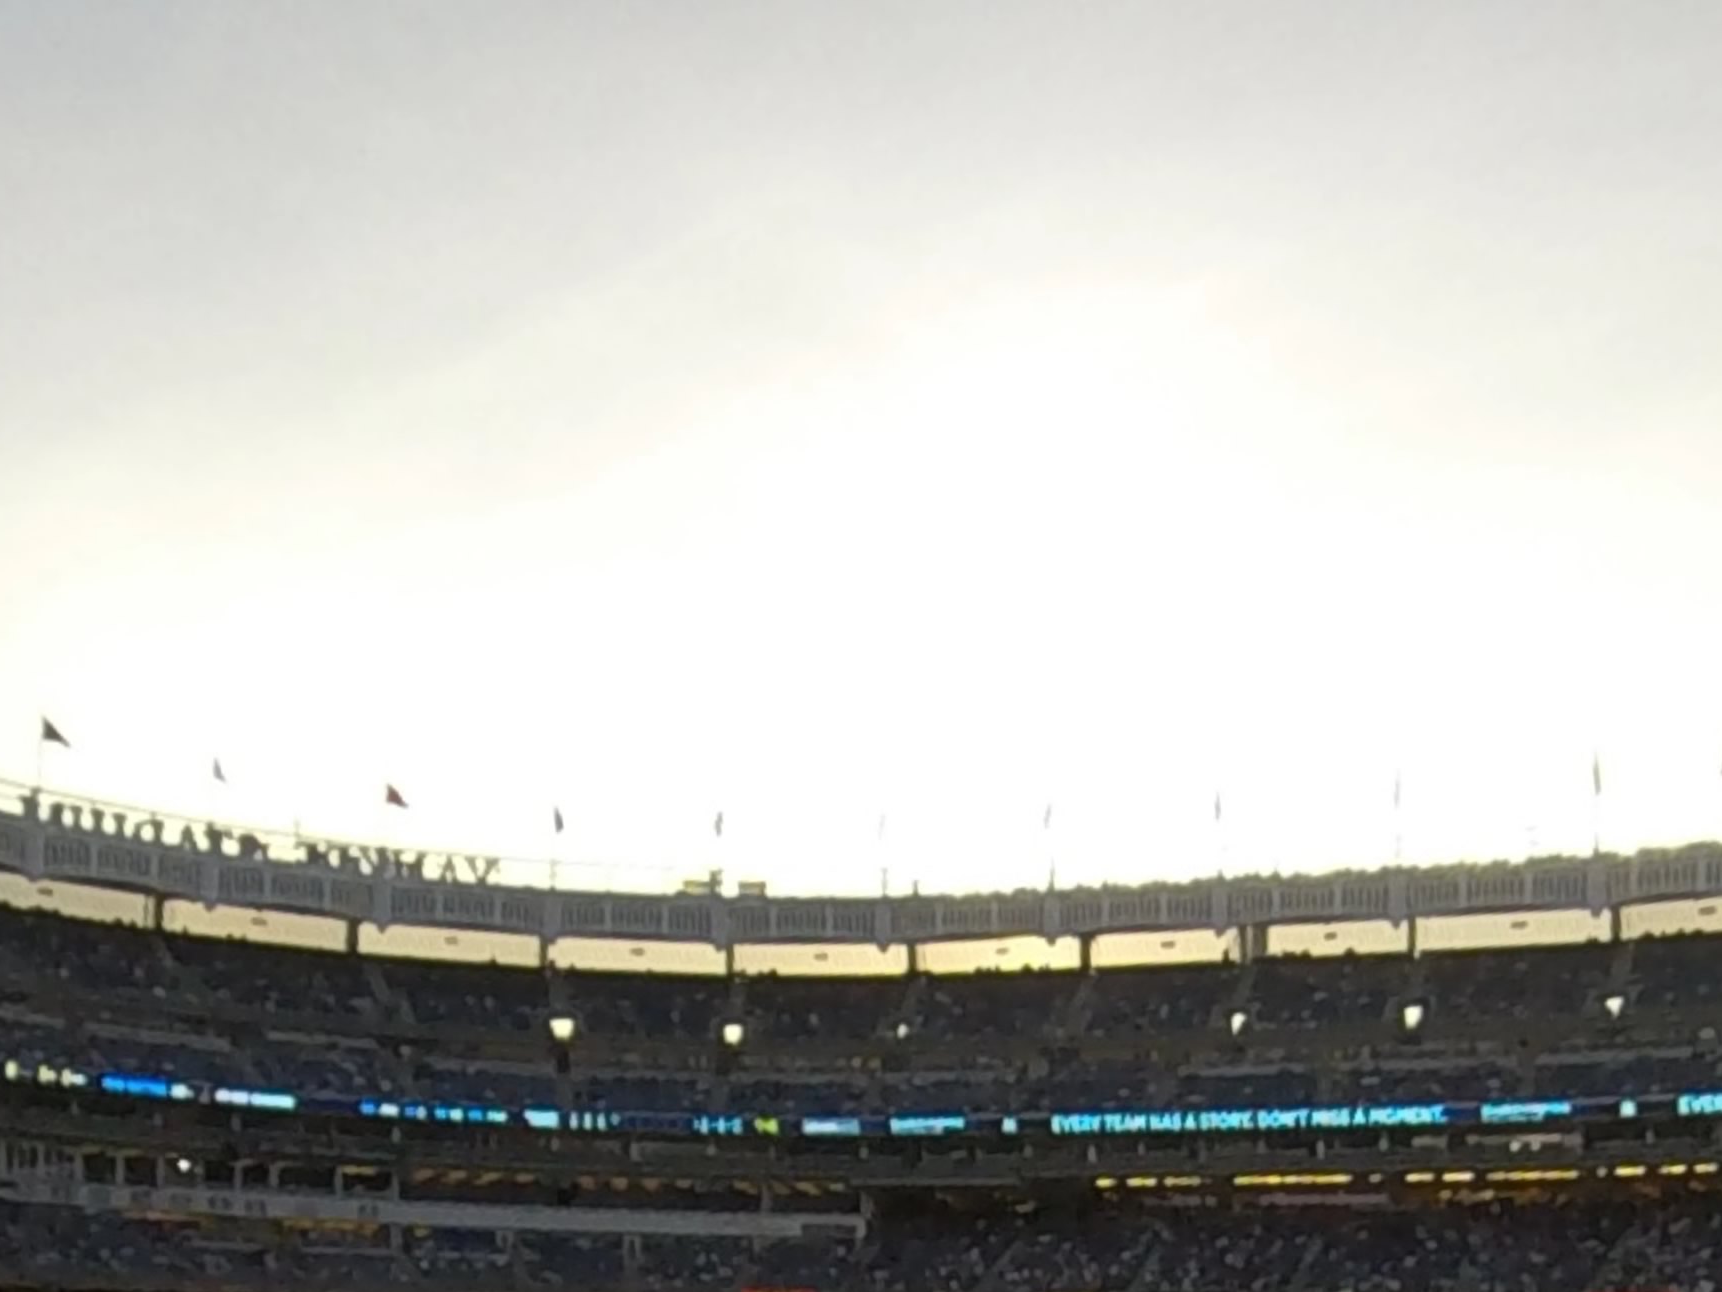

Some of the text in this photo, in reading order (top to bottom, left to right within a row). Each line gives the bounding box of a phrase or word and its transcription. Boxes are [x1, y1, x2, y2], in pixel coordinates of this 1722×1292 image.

[1051, 1112, 1101, 1135] EVERY
[1104, 1112, 1147, 1133] TEAM
[1149, 1112, 1181, 1133] HAS
[1199, 1111, 1252, 1131] STORY.
[1258, 1108, 1310, 1130] DON'T
[1311, 1106, 1350, 1129] MISS
